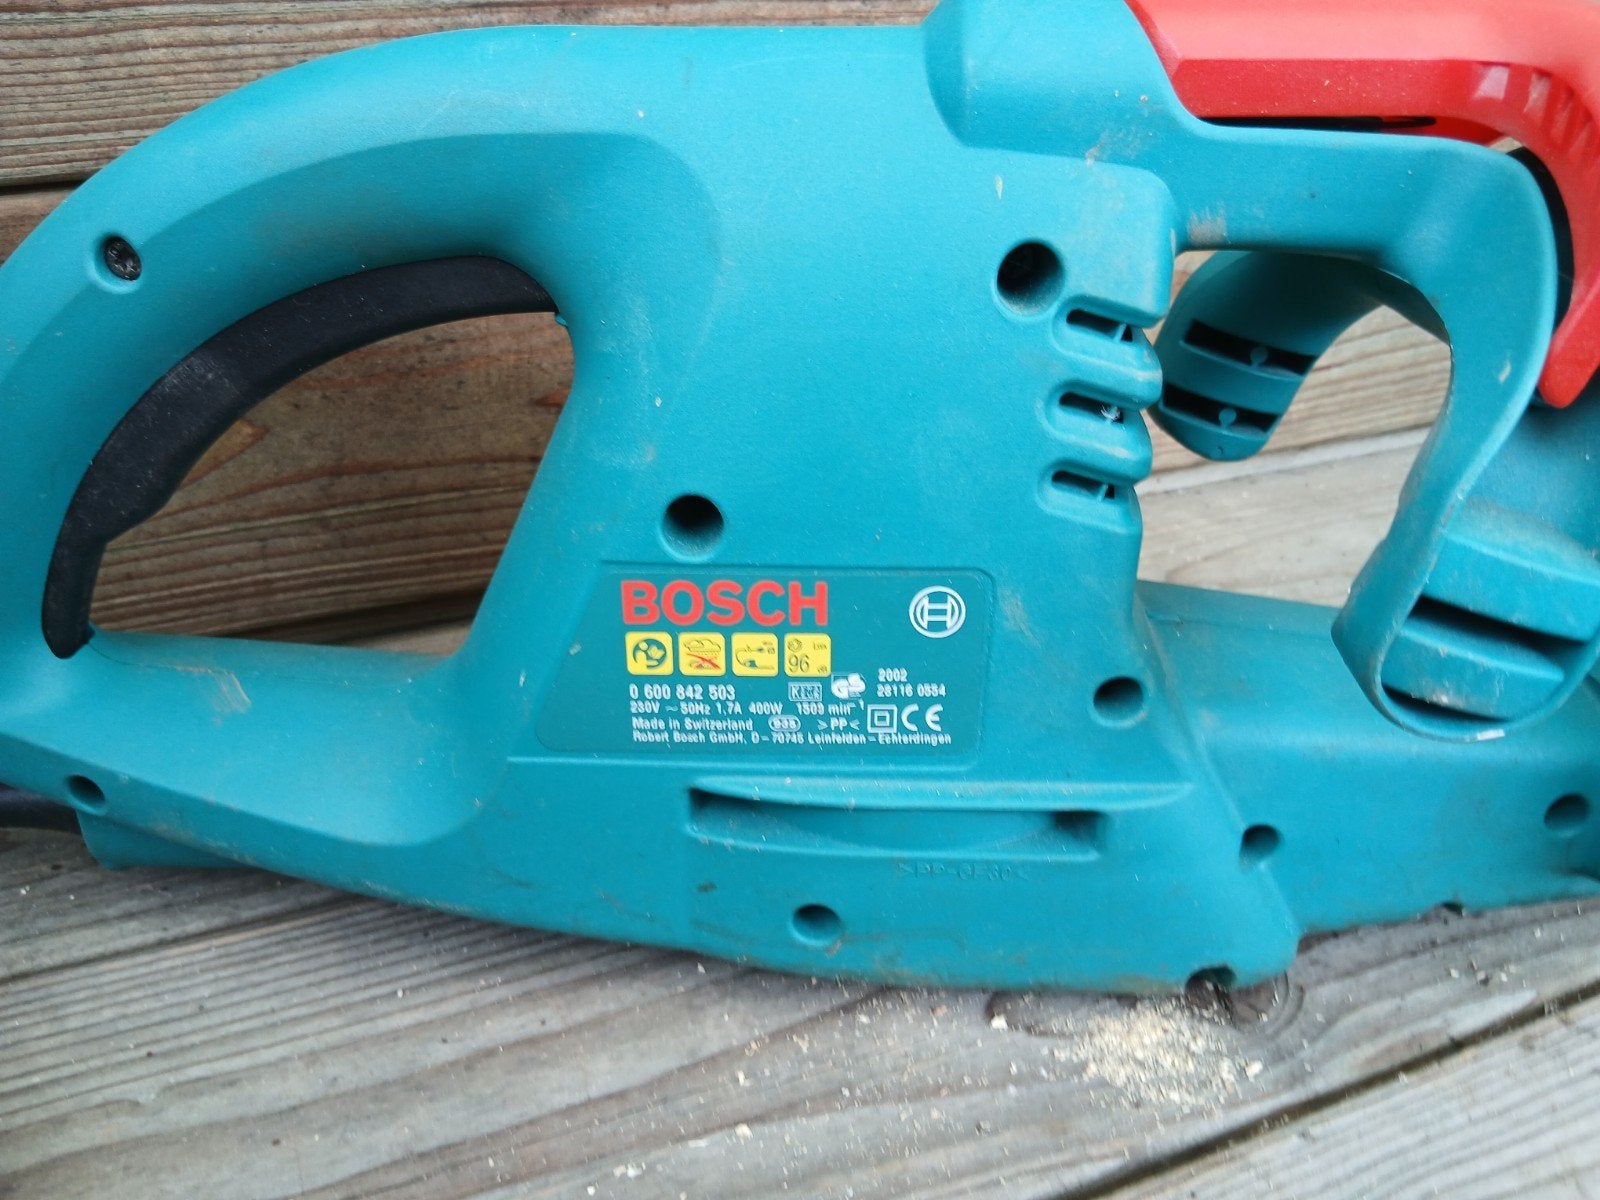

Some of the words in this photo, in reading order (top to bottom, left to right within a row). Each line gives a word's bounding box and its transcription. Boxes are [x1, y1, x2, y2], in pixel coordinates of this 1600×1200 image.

[621, 580, 828, 626] BOSCH
[788, 653, 810, 673] 96
[878, 667, 908, 682] 2002
[629, 683, 639, 700] 0
[644, 683, 671, 700] 600
[676, 683, 703, 700] 842
[708, 684, 736, 701] 503
[630, 700, 660, 714] 230V
[749, 701, 783, 715] 400W
[631, 716, 666, 730] Made
[669, 717, 681, 730] in
[684, 717, 753, 731] Switzerland
[632, 730, 670, 743] Robert
[673, 730, 706, 743] Bosch
